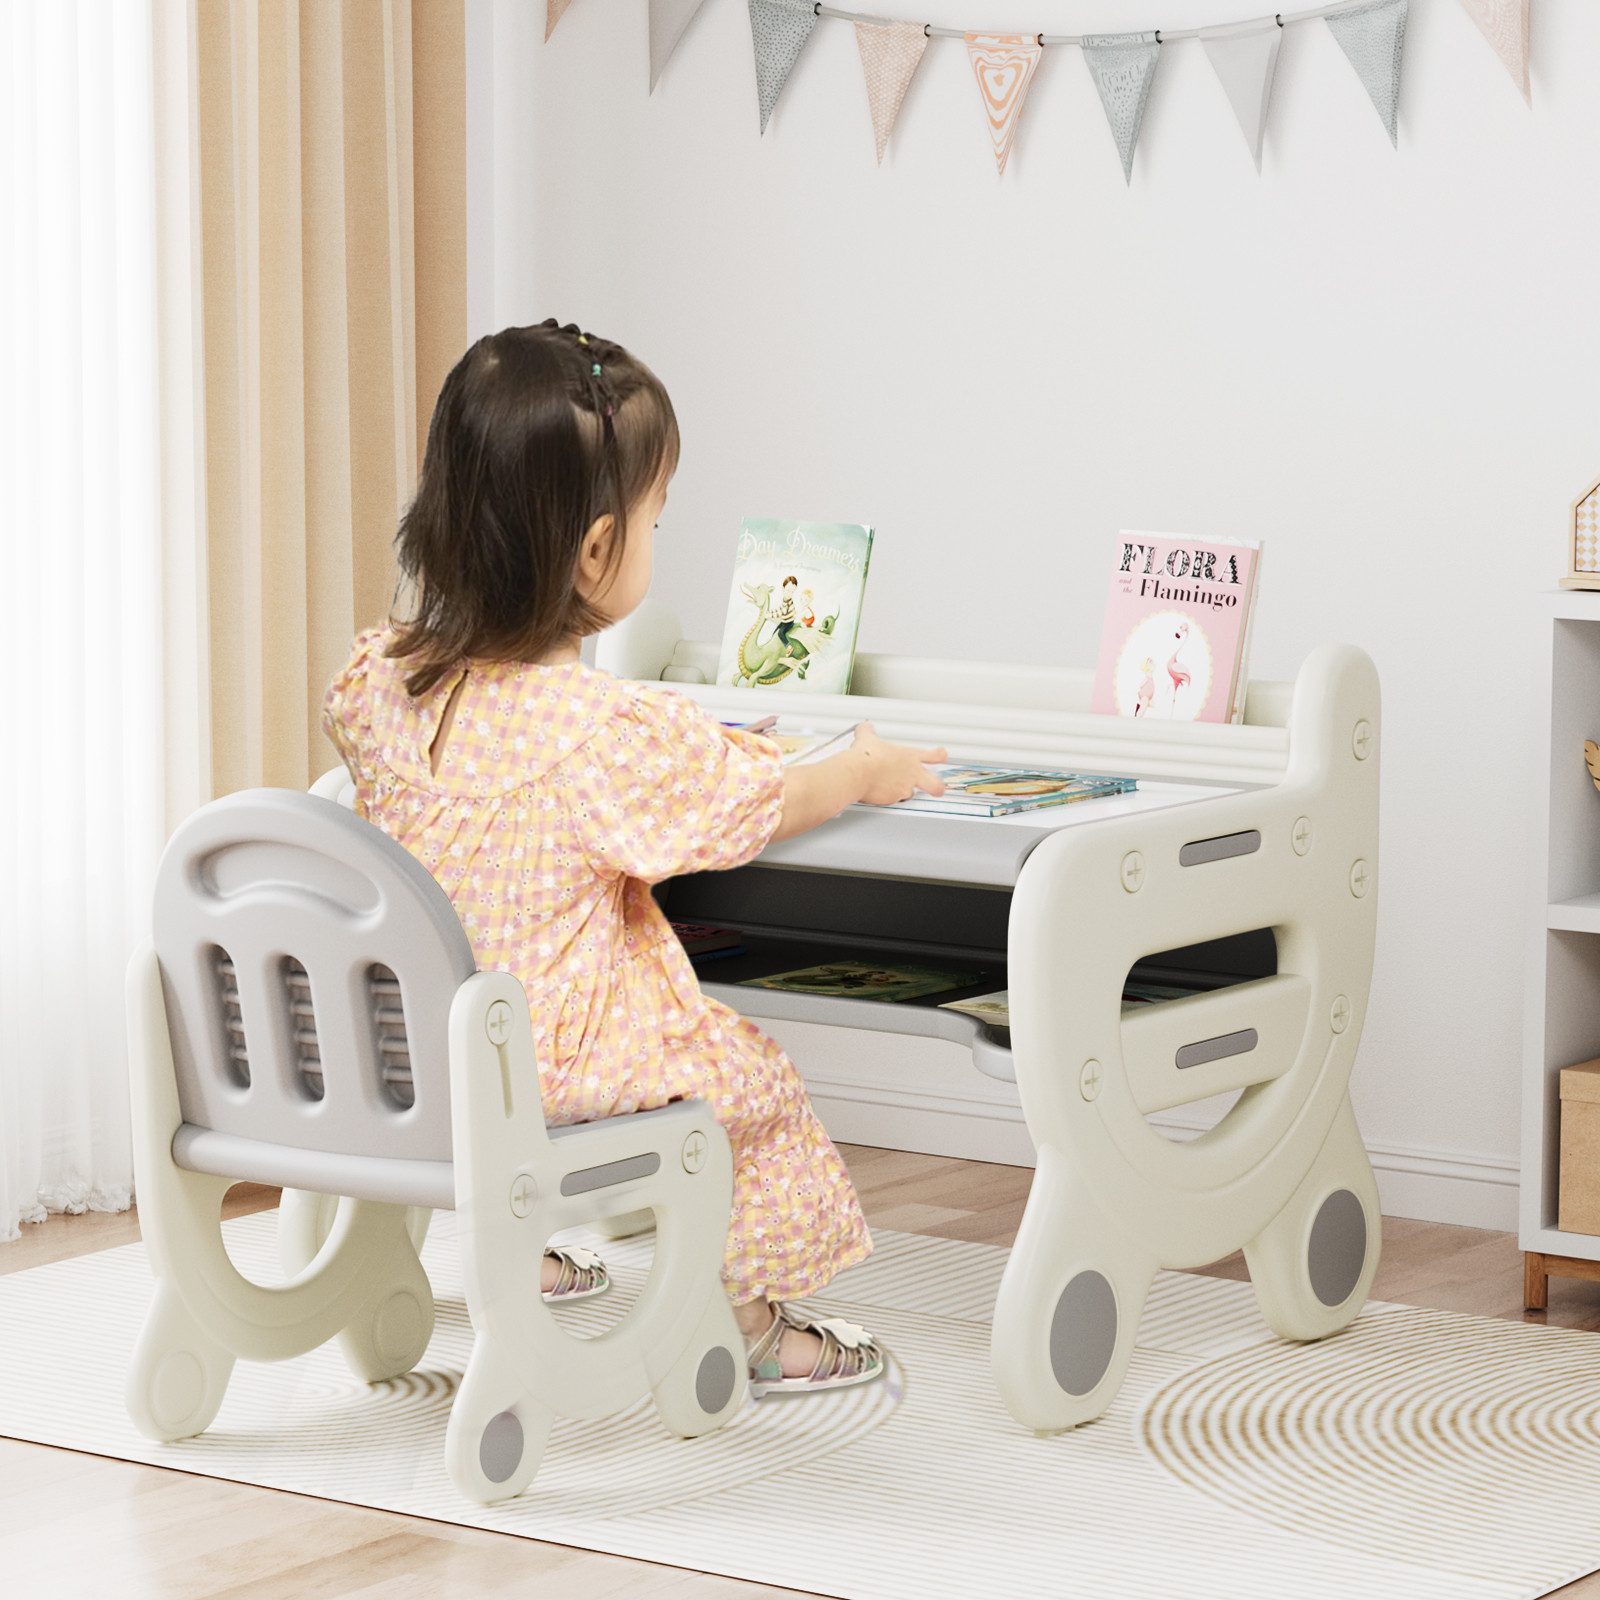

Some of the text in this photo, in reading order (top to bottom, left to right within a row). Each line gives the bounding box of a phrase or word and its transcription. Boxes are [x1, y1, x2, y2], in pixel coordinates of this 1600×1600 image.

[737, 526, 861, 573] Day Dreamers
[1119, 543, 1242, 585] FLORA
[1140, 578, 1237, 612] Flamingo
